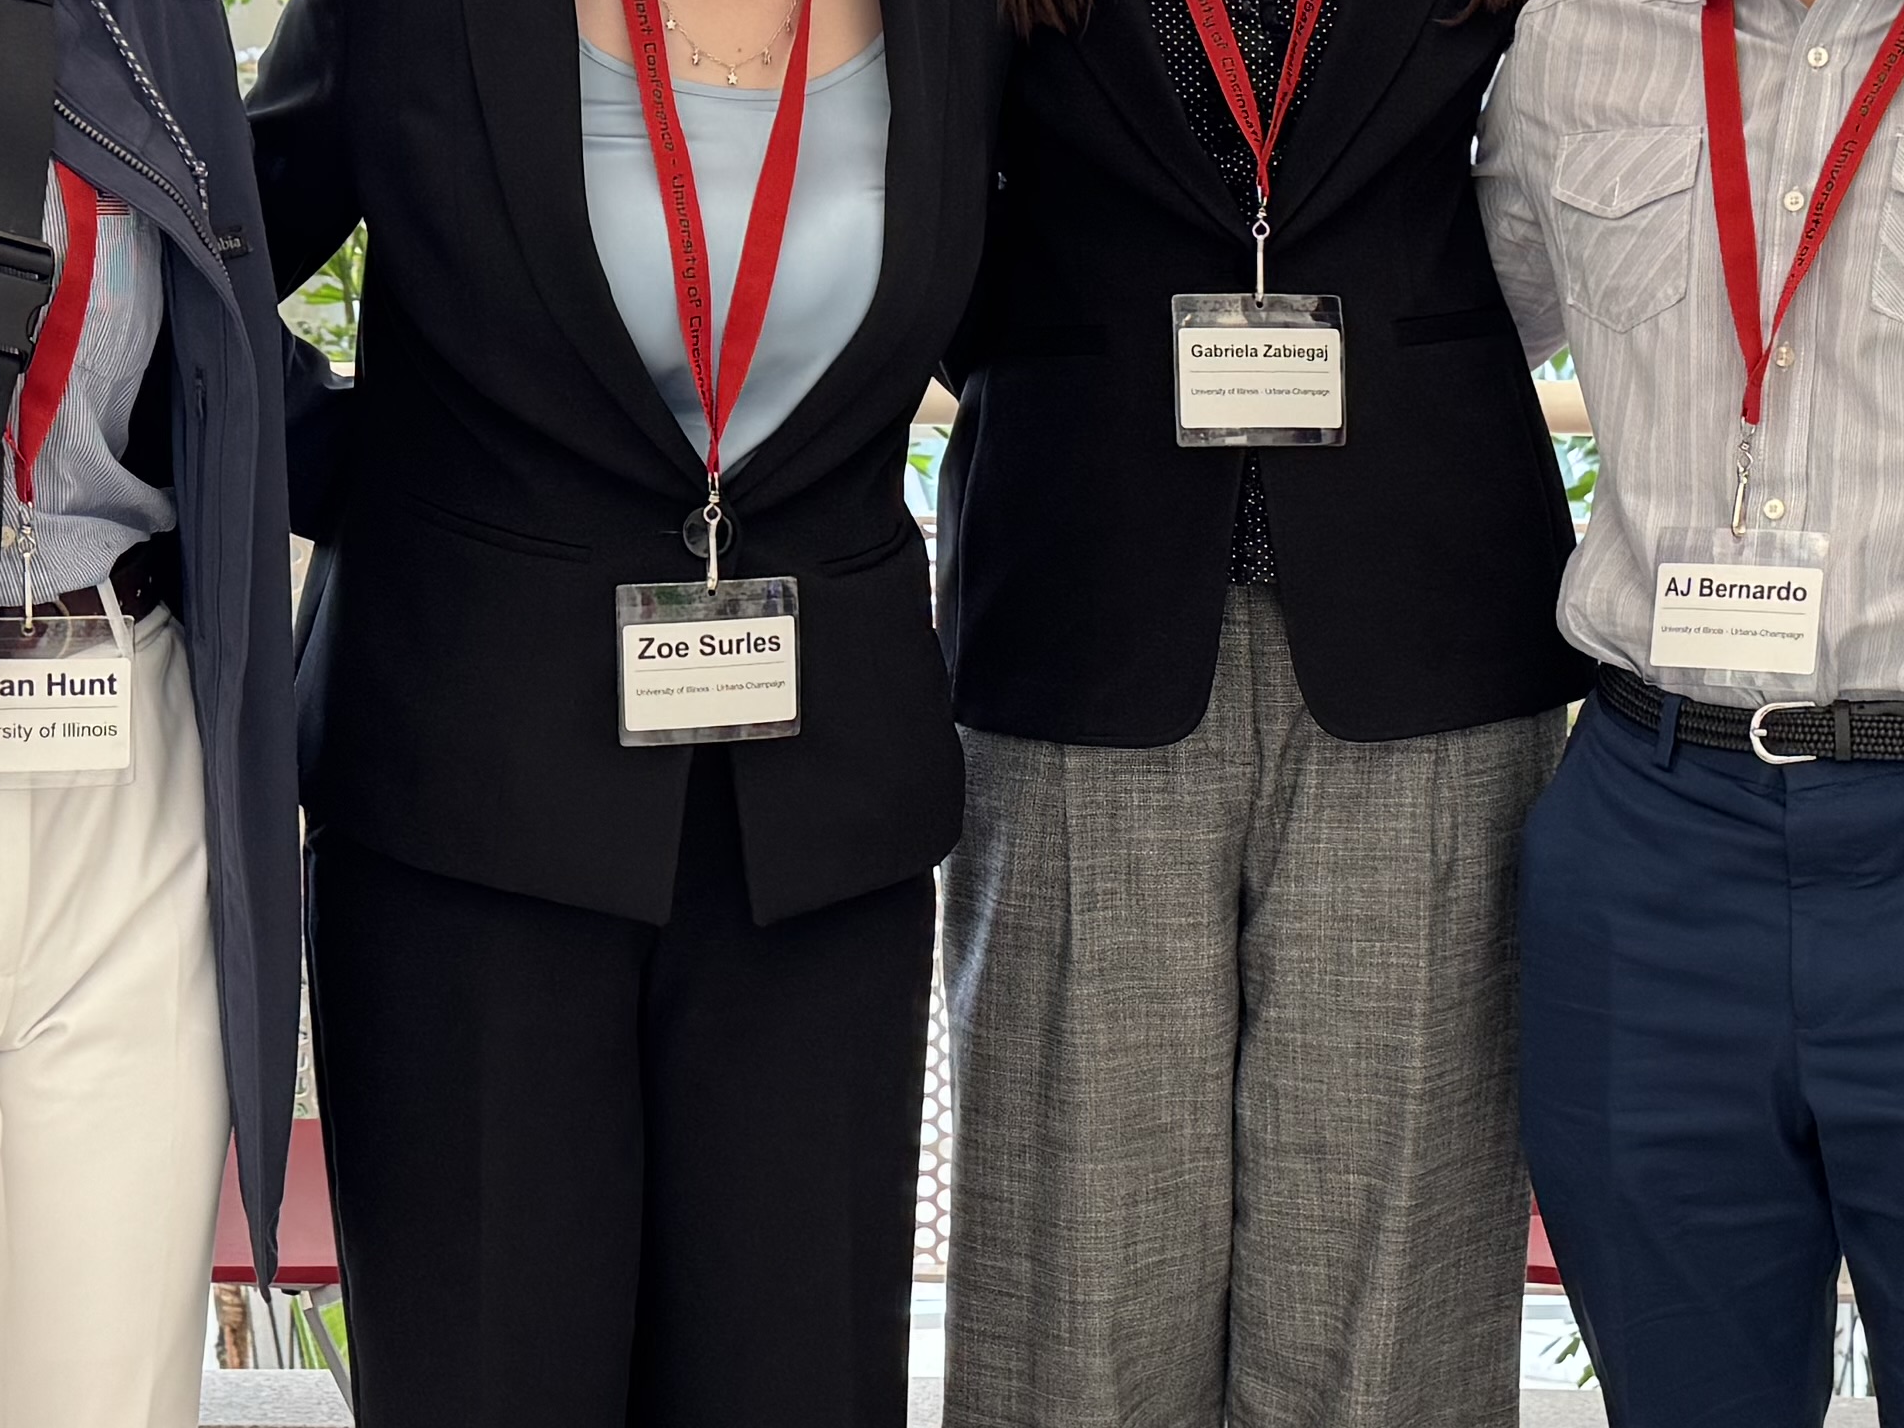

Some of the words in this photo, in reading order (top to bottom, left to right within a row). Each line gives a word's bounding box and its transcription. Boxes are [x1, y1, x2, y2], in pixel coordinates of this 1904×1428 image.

[1210, 31, 1228, 52] of
[644, 42, 675, 153] Conference
[673, 174, 696, 280] University
[687, 286, 702, 309] of
[1805, 139, 1859, 240] University
[1190, 343, 1258, 359] Gabriela
[1262, 343, 1329, 362] Zabiegaj
[1664, 577, 1692, 598] AJ
[1699, 578, 1808, 602] Bernardo
[637, 637, 690, 661] Zoe
[699, 632, 782, 657] Surles
[47, 672, 118, 697] Hunt
[39, 722, 57, 738] of
[62, 721, 119, 738] Illinois
